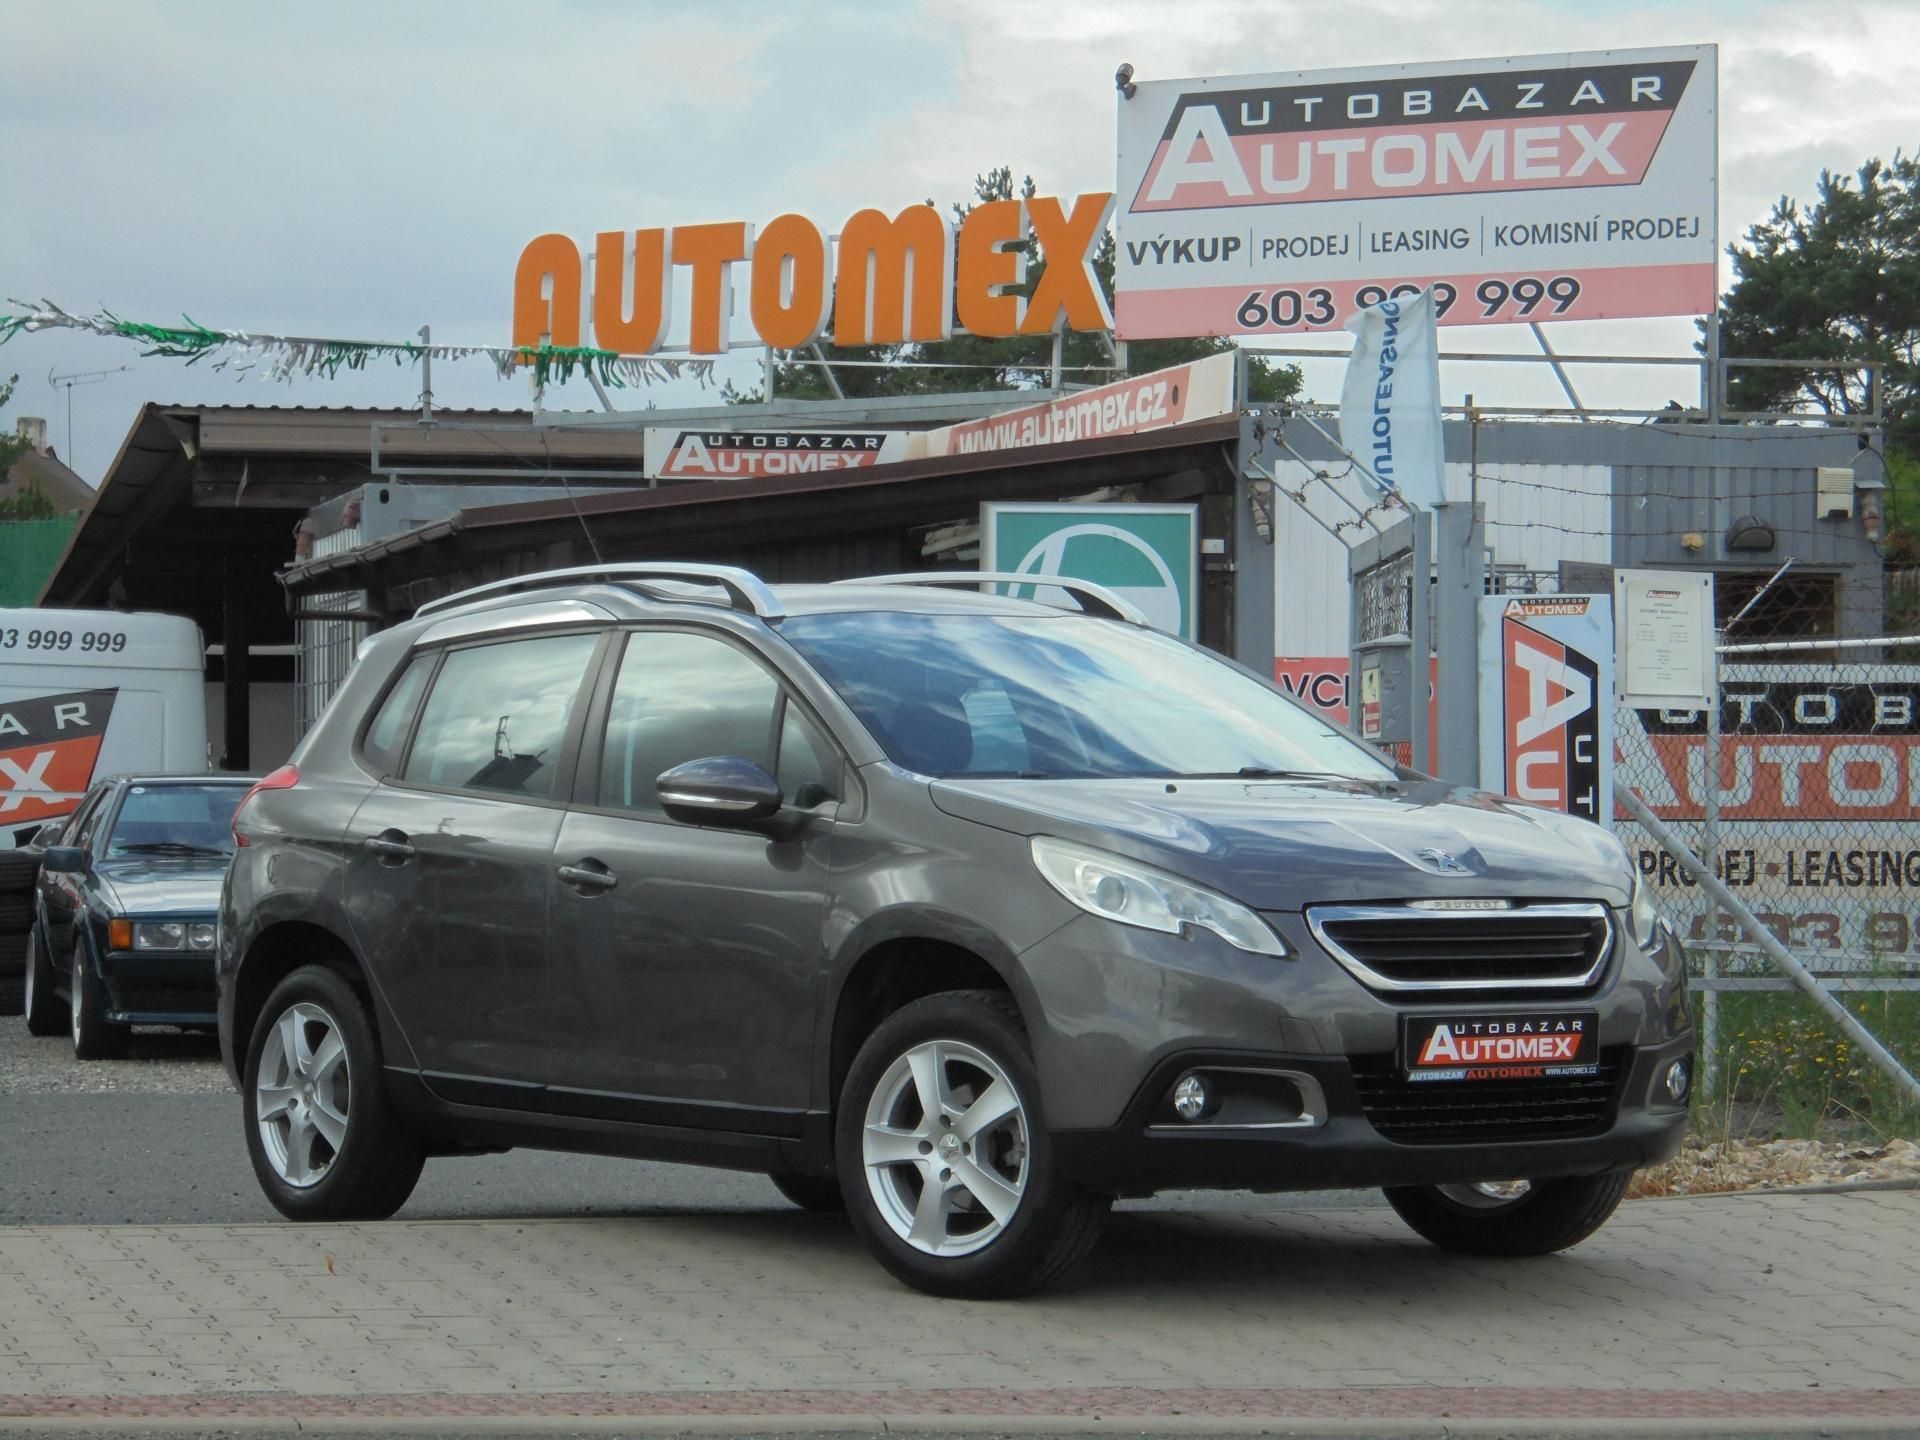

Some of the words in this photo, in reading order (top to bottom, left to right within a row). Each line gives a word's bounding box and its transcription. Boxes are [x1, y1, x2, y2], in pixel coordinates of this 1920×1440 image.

[1146, 105, 1627, 202] AUTOMEX
[1127, 231, 1241, 266] VÝKUP
[1261, 234, 1350, 260] PRODEJ
[1370, 226, 1471, 254] LEASING
[1494, 214, 1600, 247] KOMISNÍ
[1606, 216, 1701, 242] PRODEJ
[514, 192, 1114, 364] AUTOMEX
[1236, 288, 1336, 328] 603
[1476, 276, 1581, 317] 999
[959, 380, 1167, 454] www.automex.cz
[670, 435, 864, 473] AUTOMEX
[1505, 600, 1583, 615] AUTOMEX
[27, 629, 73, 650] 999
[80, 632, 127, 653] 999
[1612, 709, 1920, 807] AUTO
[1787, 850, 1920, 887] LEASING
[1424, 1025, 1572, 1061] AUTOMEX
[1408, 1071, 1464, 1081] AUTOBAZAR
[1466, 1067, 1543, 1080] AUTOMEX
[1545, 1066, 1597, 1076] WWW.AUTOMEX.CZ
